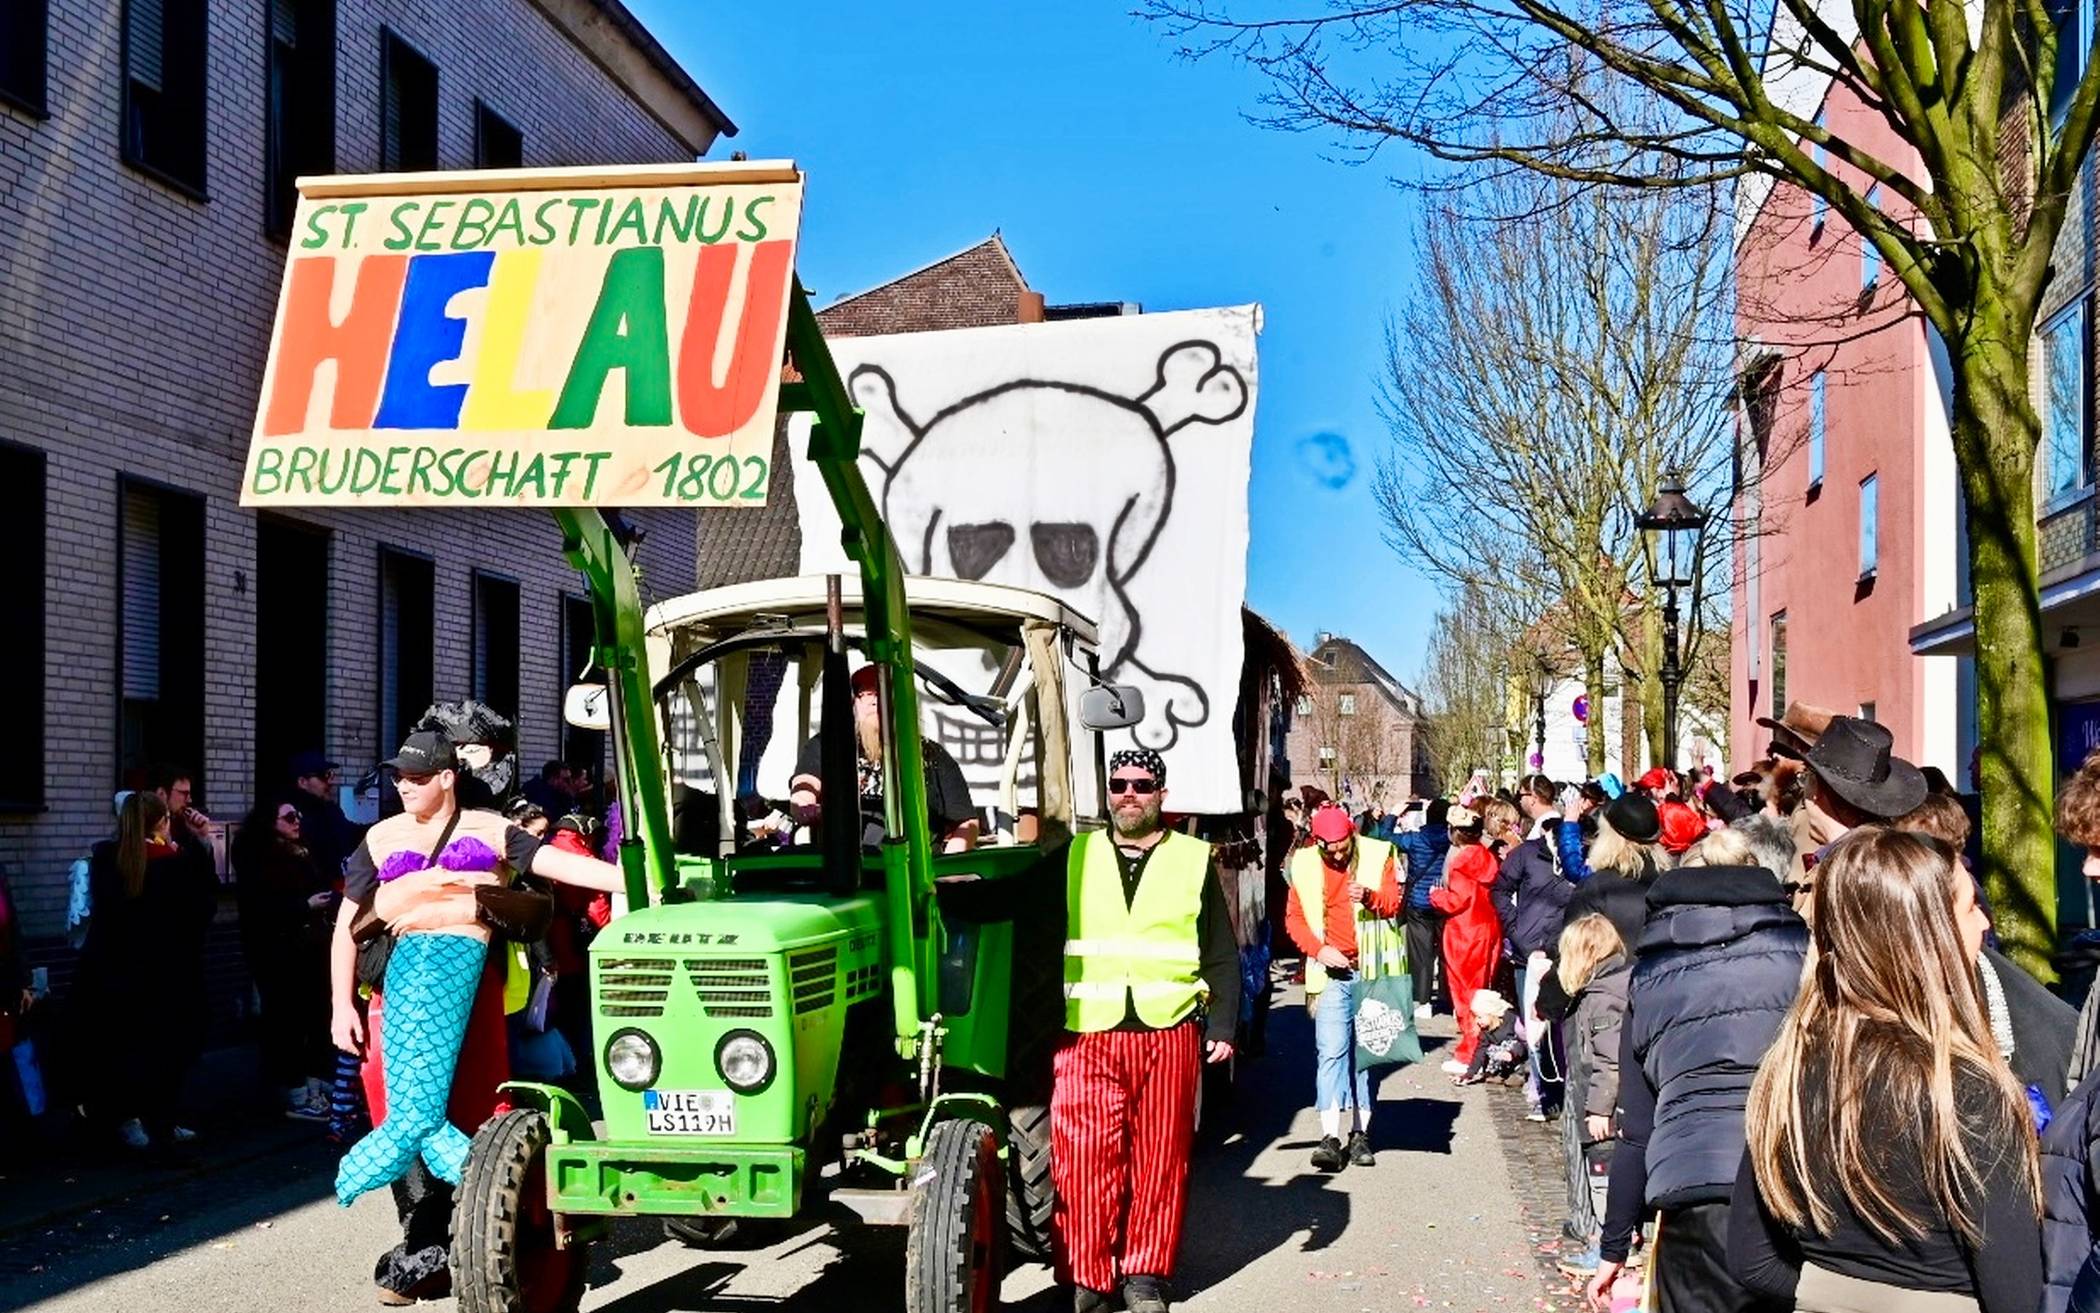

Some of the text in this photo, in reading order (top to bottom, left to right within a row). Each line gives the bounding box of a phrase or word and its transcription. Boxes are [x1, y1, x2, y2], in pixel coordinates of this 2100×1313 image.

[301, 195, 776, 250] ST. SEBASTIANUS
[263, 239, 792, 438] HELAU
[252, 446, 768, 501] BRUDERSCHAFT 1802
[659, 1094, 699, 1112] VIE
